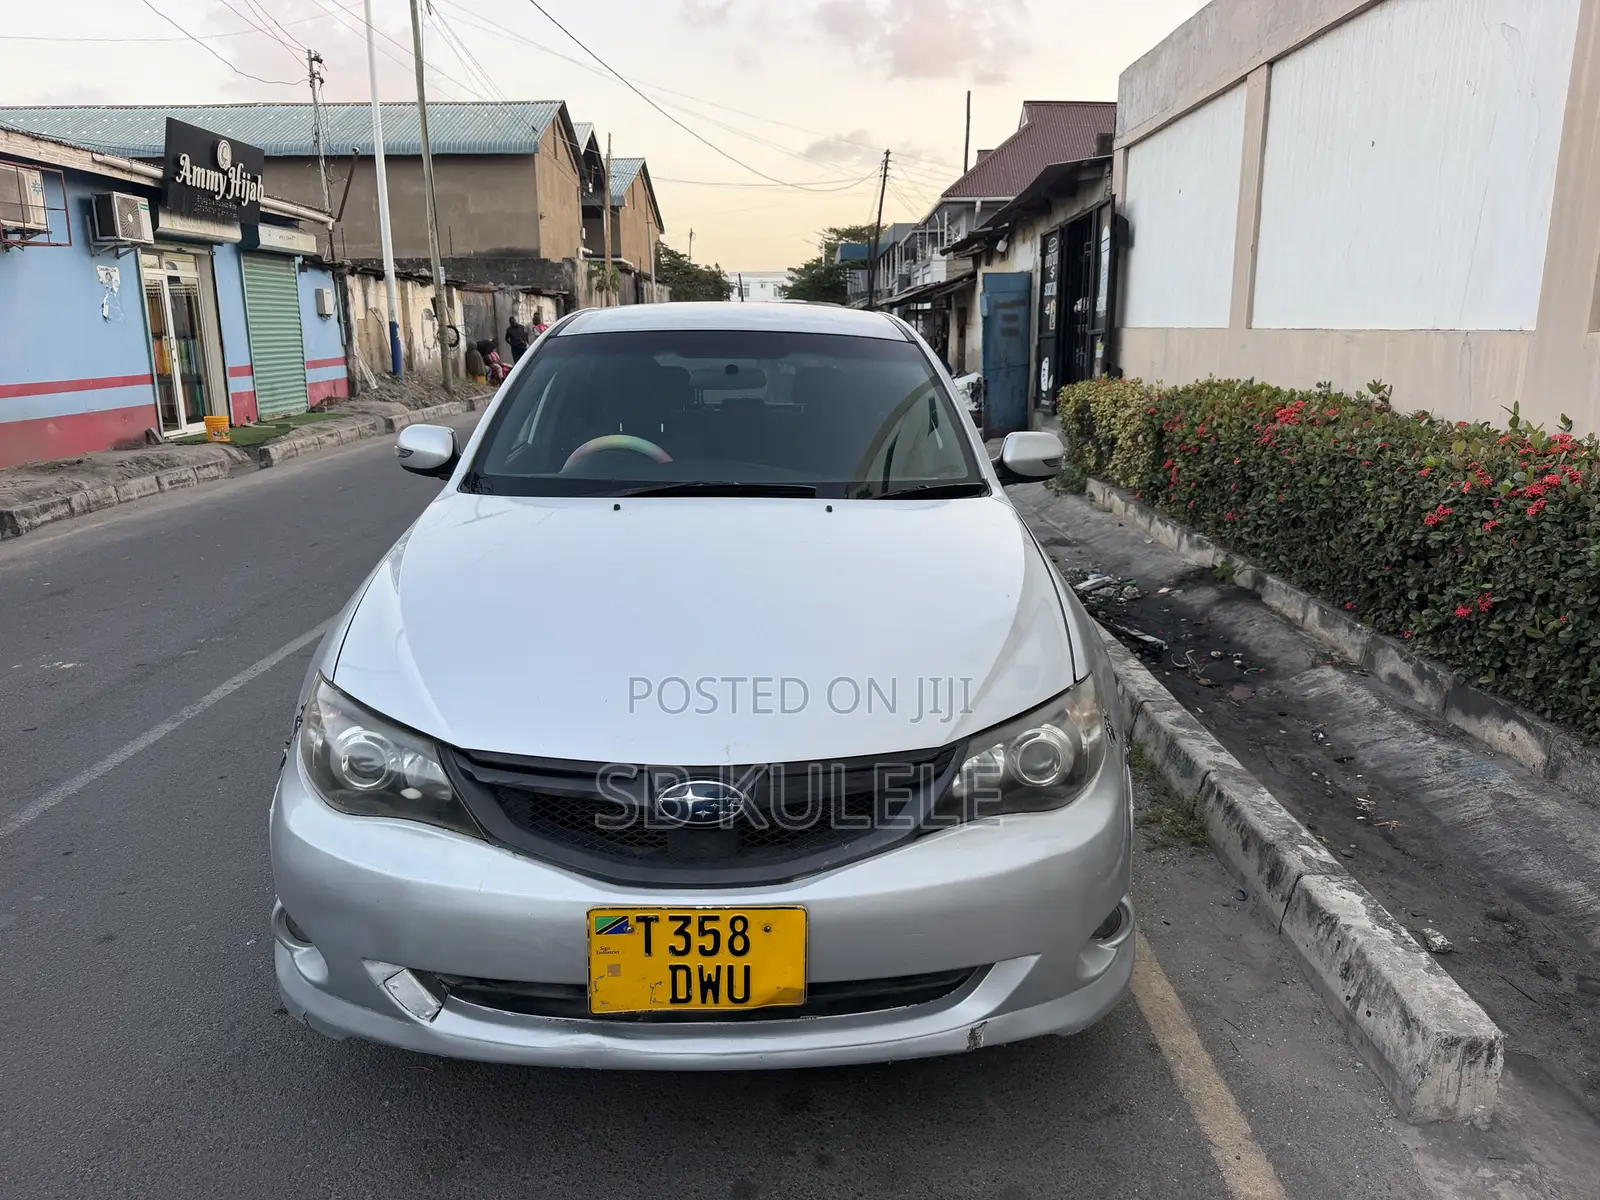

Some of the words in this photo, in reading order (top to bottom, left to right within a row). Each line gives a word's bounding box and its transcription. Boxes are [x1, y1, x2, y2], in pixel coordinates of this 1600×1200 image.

[176, 153, 227, 200] Ammy
[226, 162, 264, 206] Hijab
[668, 964, 751, 1005] DWU
